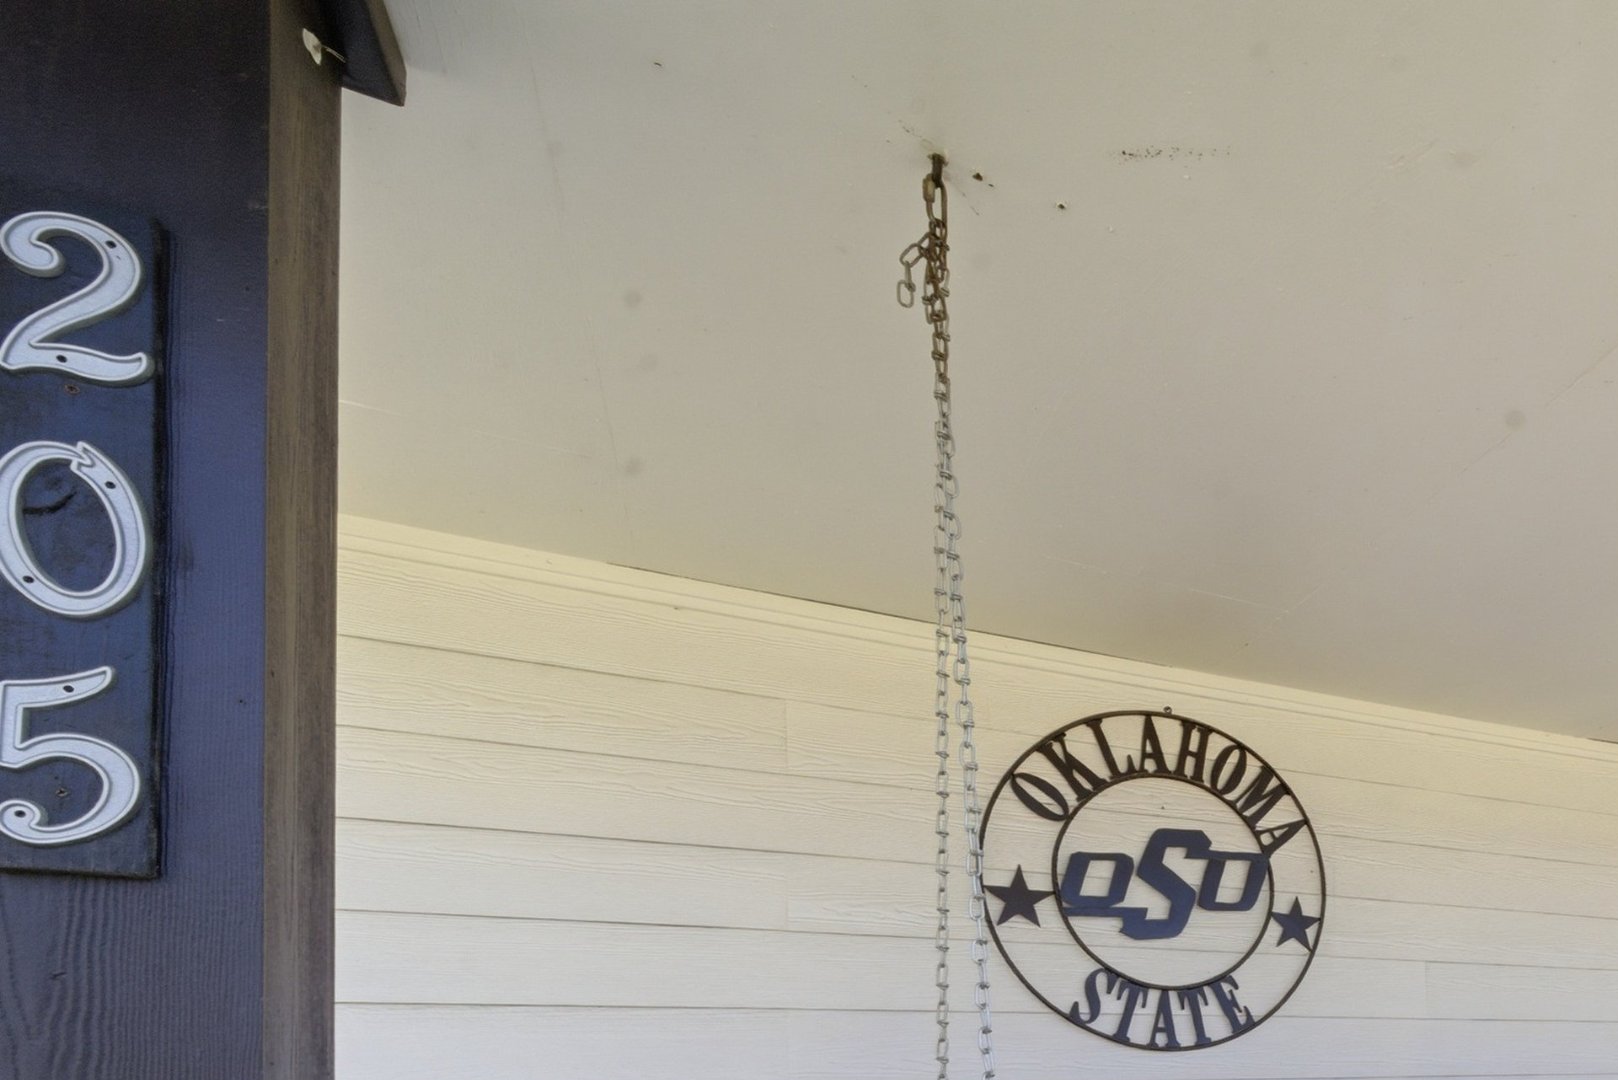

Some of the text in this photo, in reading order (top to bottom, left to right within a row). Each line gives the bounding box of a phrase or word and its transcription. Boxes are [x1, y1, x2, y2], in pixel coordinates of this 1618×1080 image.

[0, 211, 152, 844] 205
[1010, 714, 1307, 858] OKLAHOMA
[1069, 968, 1255, 1049] STATE
